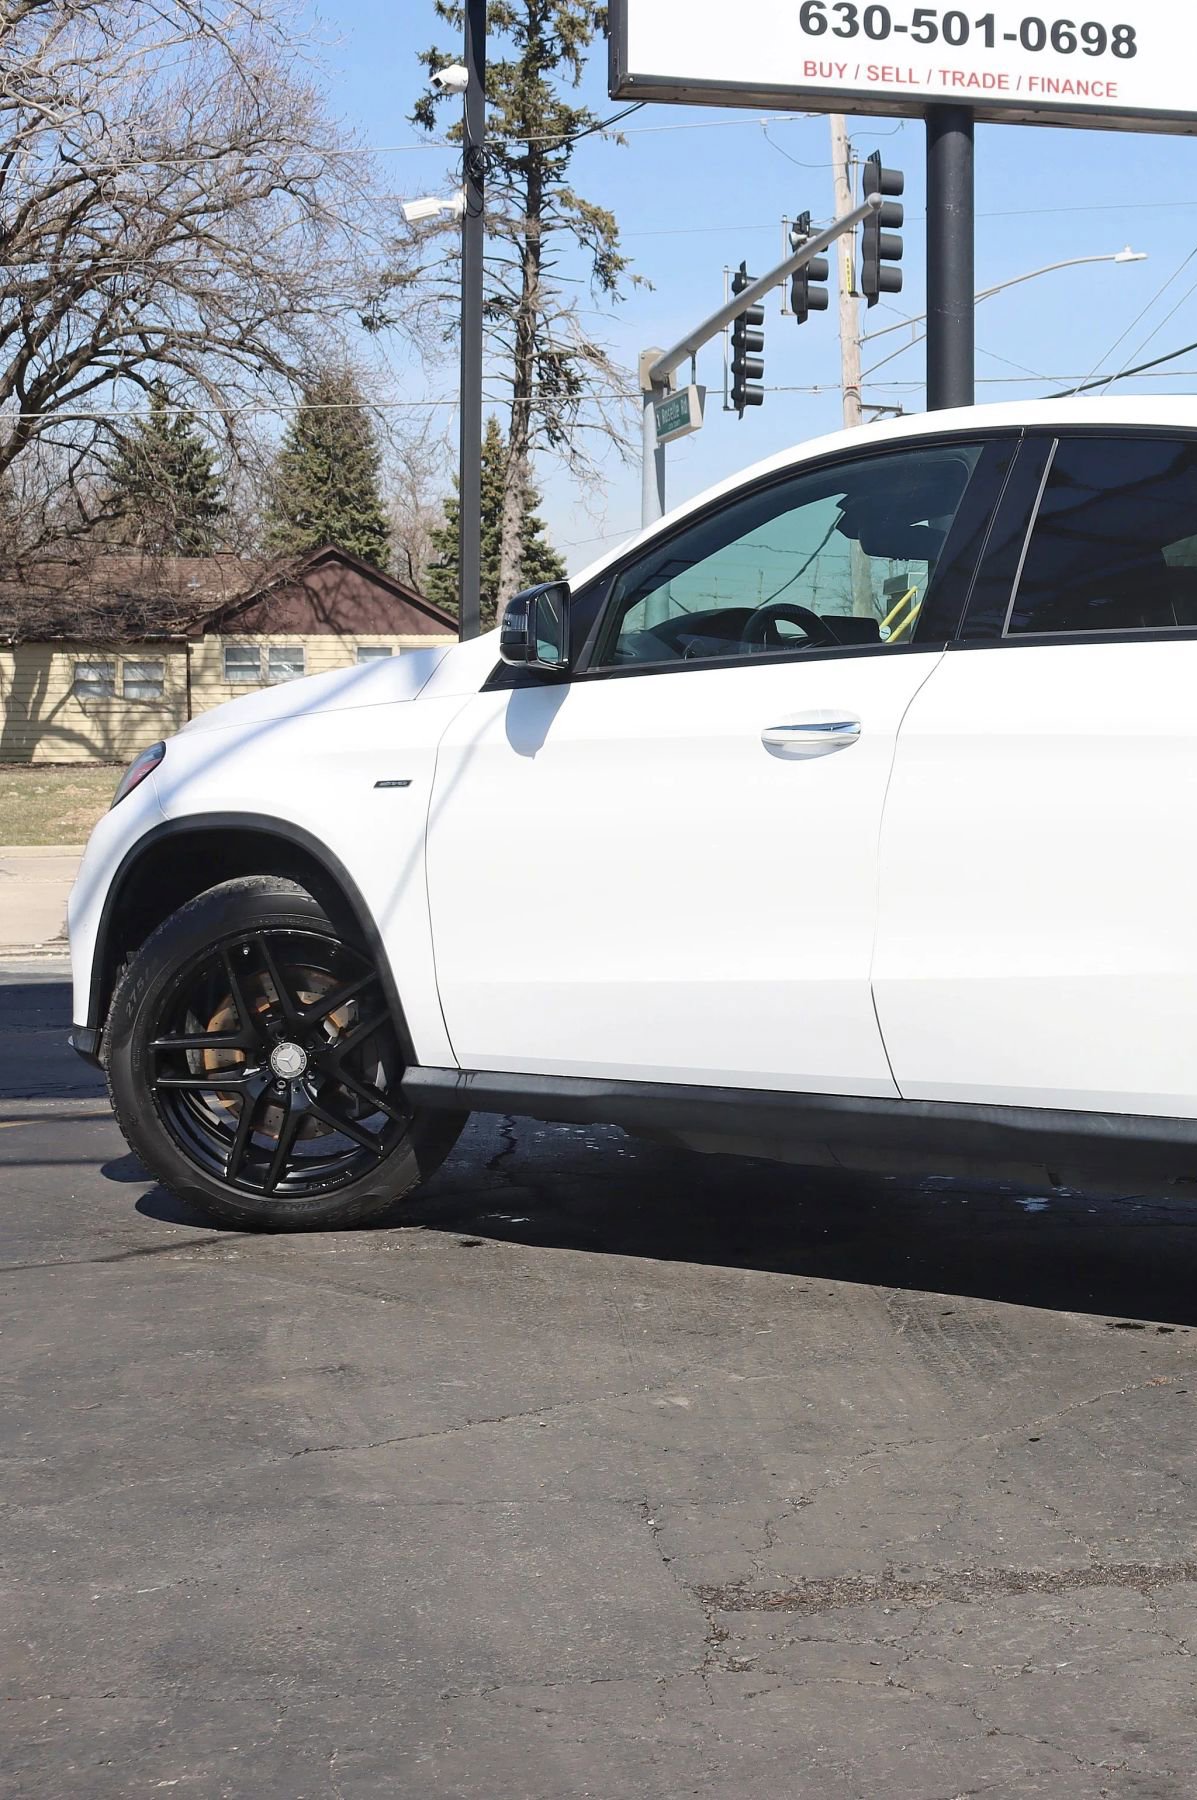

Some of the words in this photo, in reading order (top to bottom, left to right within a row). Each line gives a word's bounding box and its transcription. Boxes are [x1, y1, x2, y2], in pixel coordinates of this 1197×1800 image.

[799, 0, 1138, 59] 630-501-0698
[803, 60, 848, 79] BUY
[866, 64, 919, 84] SELL
[939, 70, 1009, 91] TRADE
[1028, 76, 1118, 98] FINANCE
